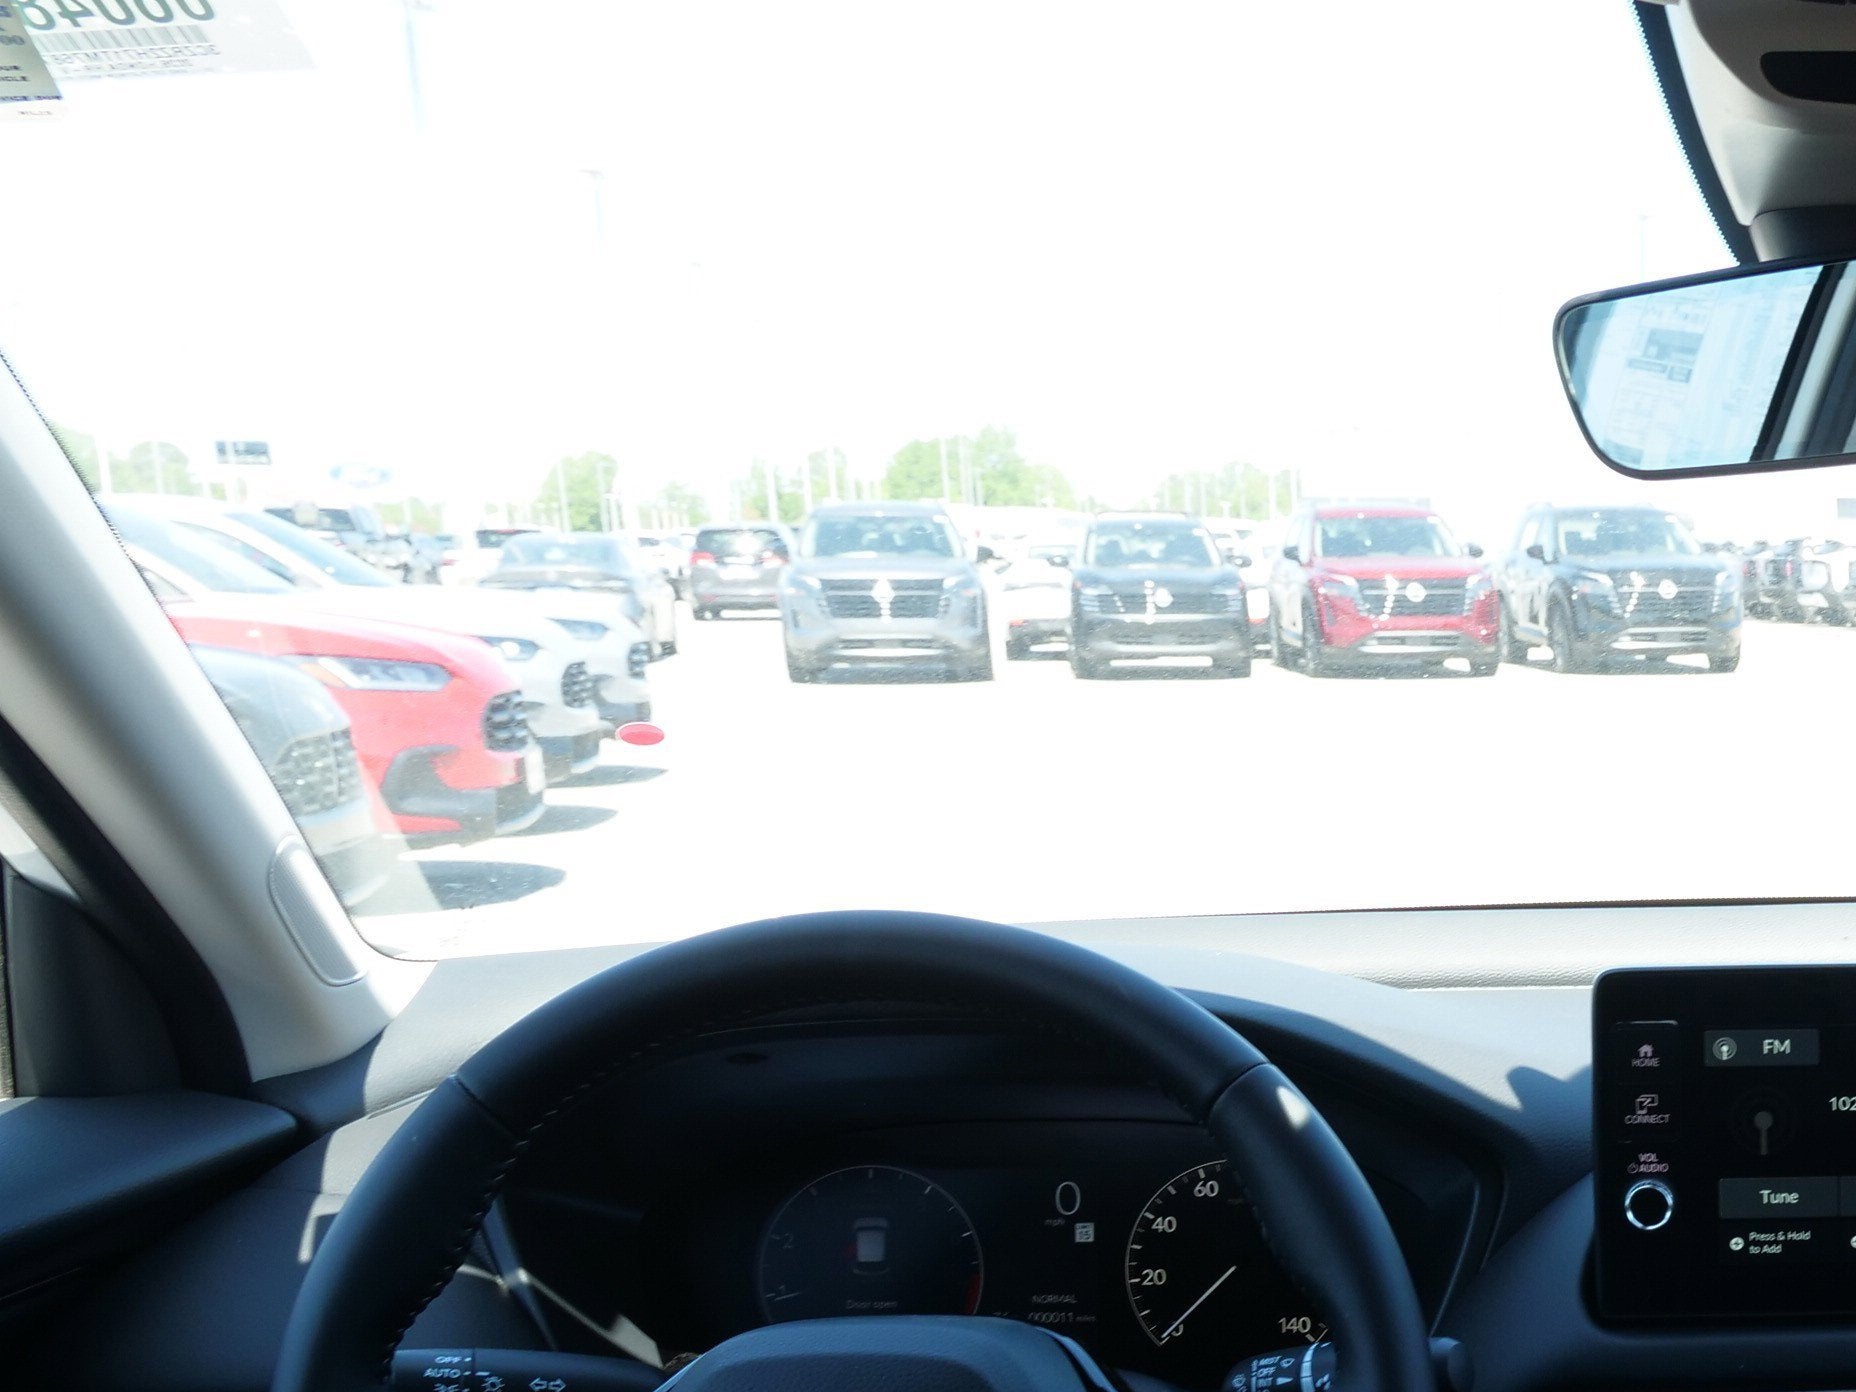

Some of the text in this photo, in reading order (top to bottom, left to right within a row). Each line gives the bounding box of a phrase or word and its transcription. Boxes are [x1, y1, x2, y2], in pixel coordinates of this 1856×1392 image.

[1762, 1039, 1791, 1055] FM
[1631, 1057, 1661, 1067] HOME
[1624, 1114, 1671, 1124] CONNECT
[1638, 1153, 1659, 1162] VOL
[1639, 1163, 1670, 1173] AUDIO
[1193, 1180, 1219, 1198] 60
[1055, 1181, 1081, 1215] 0
[1759, 1189, 1799, 1205] Tune
[1150, 1215, 1177, 1234] 40
[1749, 1230, 1811, 1242] Press & Hold
[1749, 1244, 1782, 1254] to Add
[1141, 1269, 1167, 1286] 20
[1031, 1294, 1079, 1304] NORMAL
[1278, 1317, 1311, 1333] 140
[434, 1356, 462, 1364] OFF
[422, 1368, 461, 1378] AUTO
